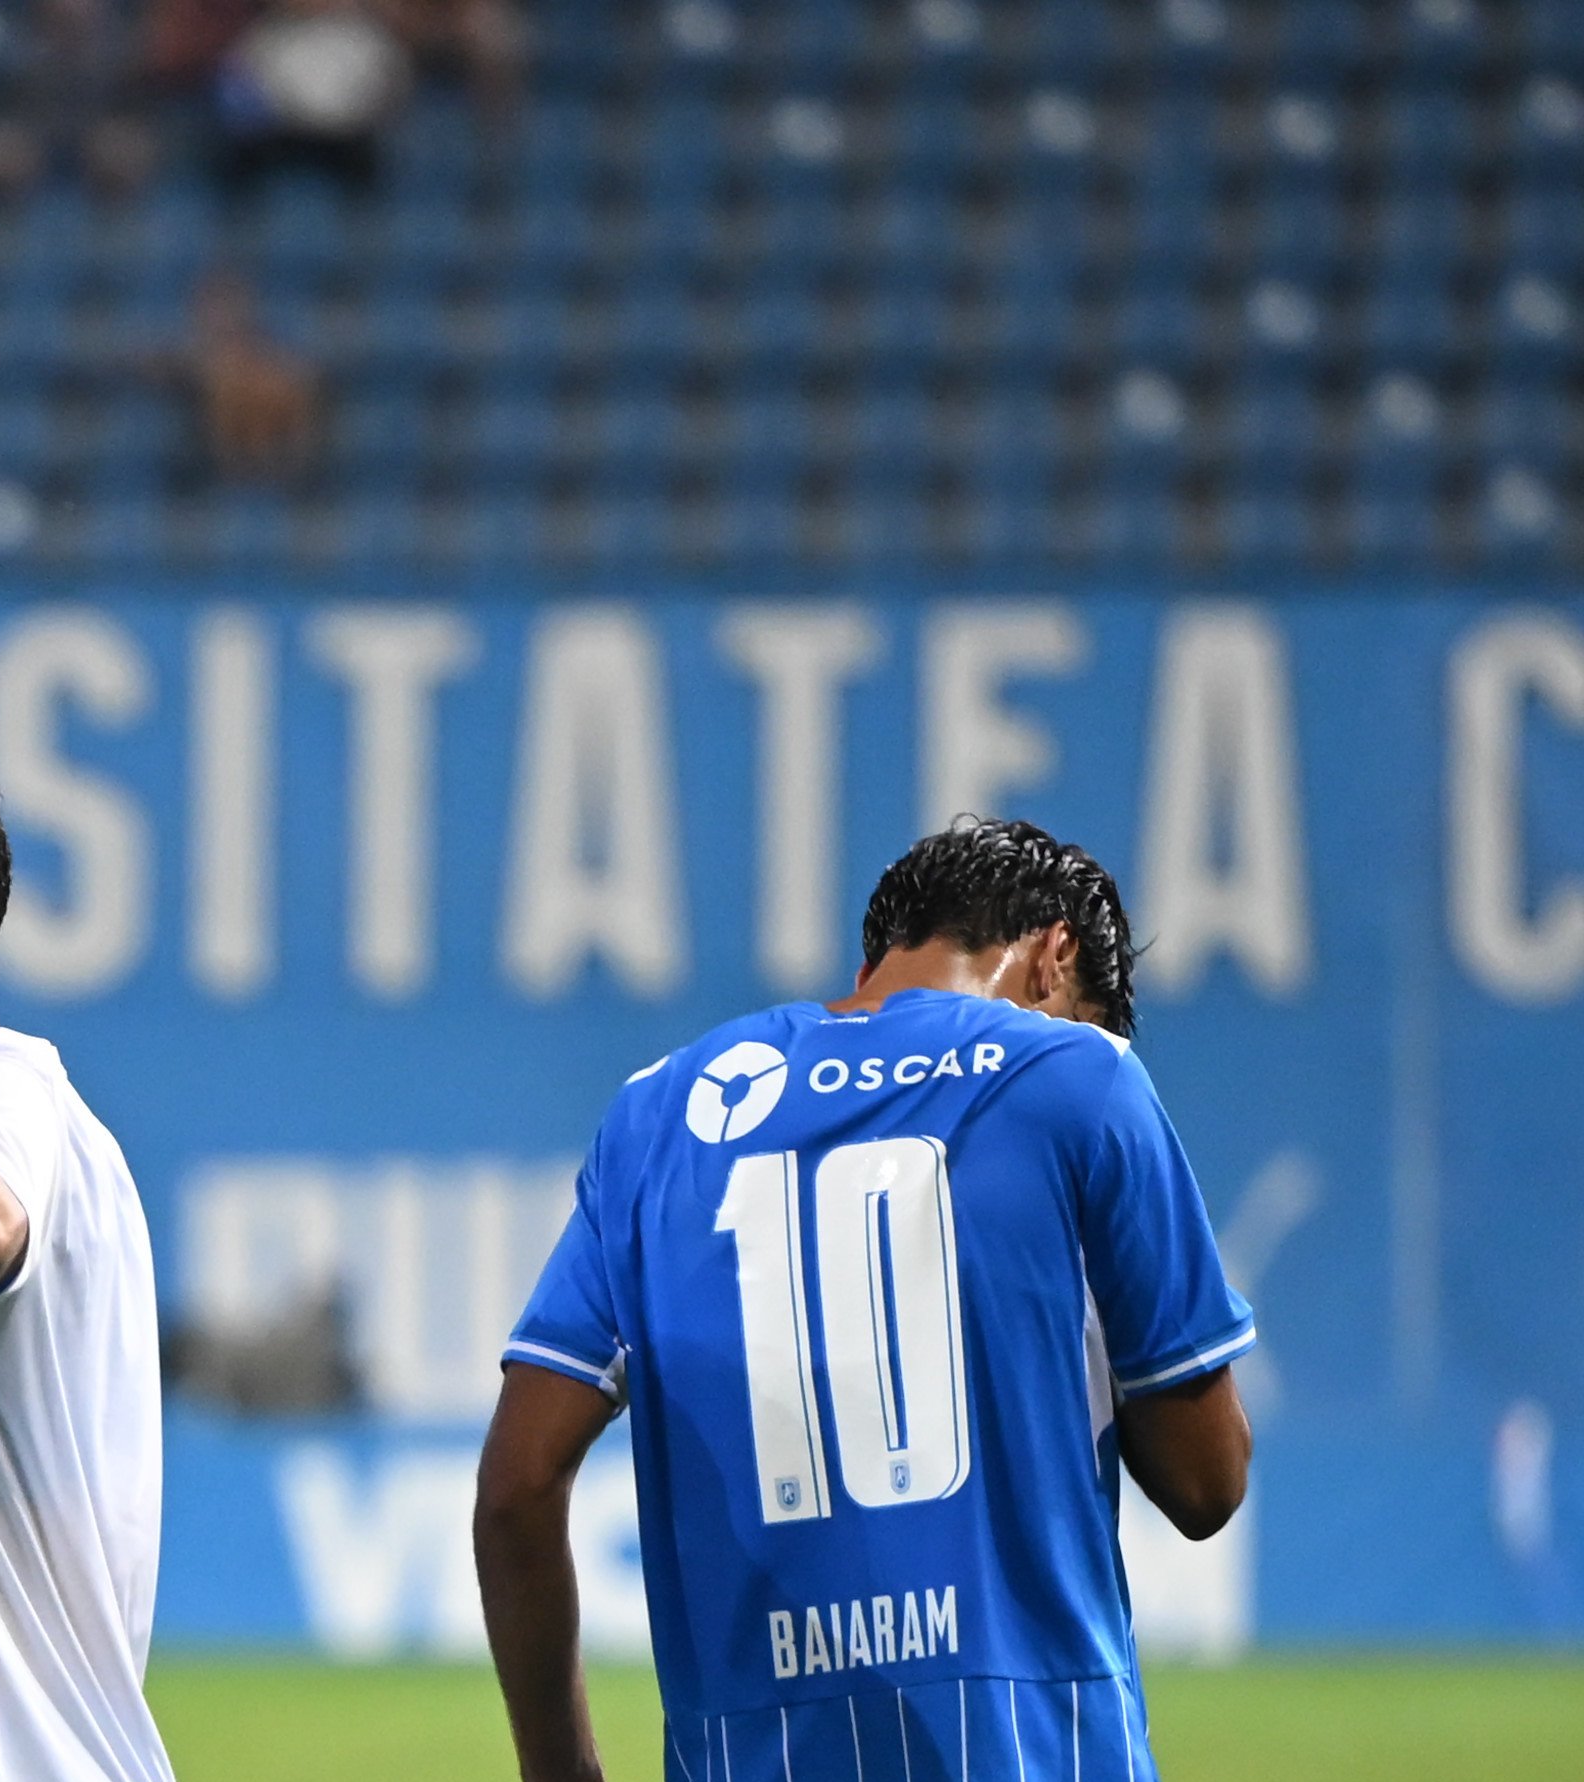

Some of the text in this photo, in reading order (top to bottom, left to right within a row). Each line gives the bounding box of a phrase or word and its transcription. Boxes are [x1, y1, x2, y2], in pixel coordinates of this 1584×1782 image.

[809, 1043, 1006, 1093] OSCAR
[713, 1134, 971, 1526] 10
[769, 1586, 959, 1680] BAIARAM
